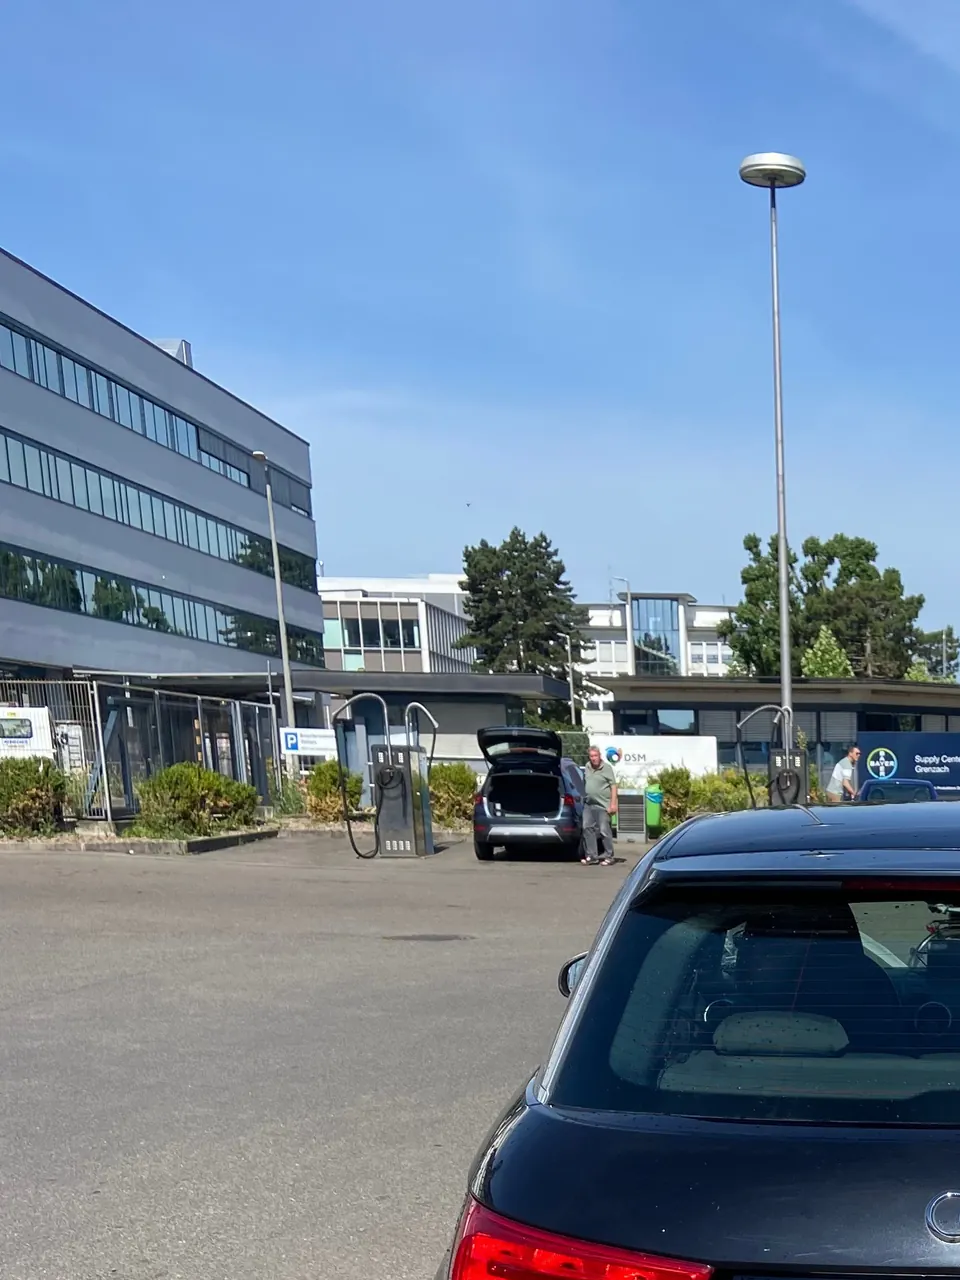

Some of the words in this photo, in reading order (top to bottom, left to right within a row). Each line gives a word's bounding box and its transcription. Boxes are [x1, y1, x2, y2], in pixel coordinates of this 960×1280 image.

[624, 754, 646, 762] DSM
[914, 755, 940, 764] Supply
[914, 765, 950, 773] Grenzach
